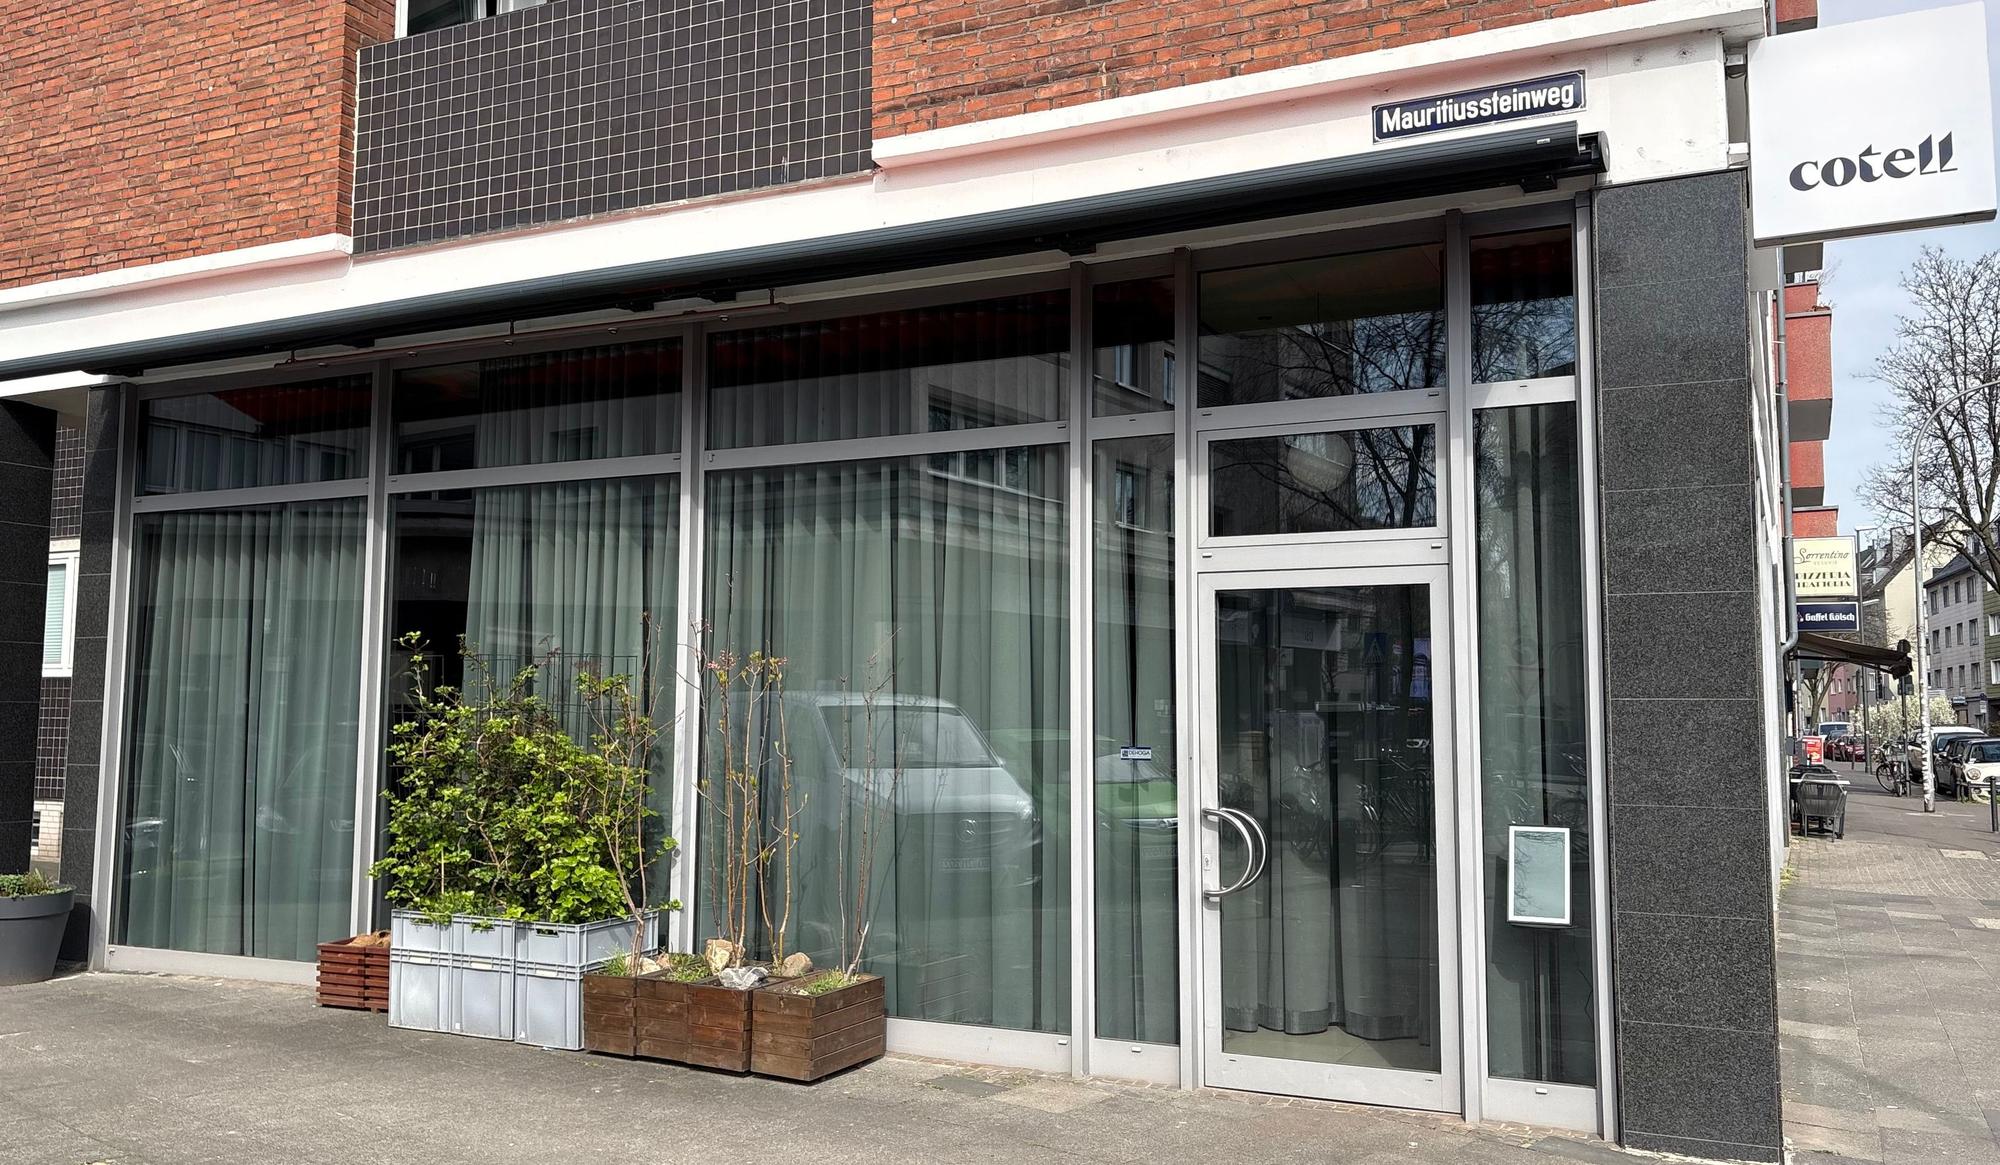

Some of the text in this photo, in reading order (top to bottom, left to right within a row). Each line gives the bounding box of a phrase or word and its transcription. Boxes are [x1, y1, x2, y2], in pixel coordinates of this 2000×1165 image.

[1382, 83, 1575, 133] Mauritiussteinweg
[1789, 131, 1958, 191] cotell
[1794, 548, 1850, 564] Sorrentino
[1805, 612, 1855, 622] Gaffel Kölsch
